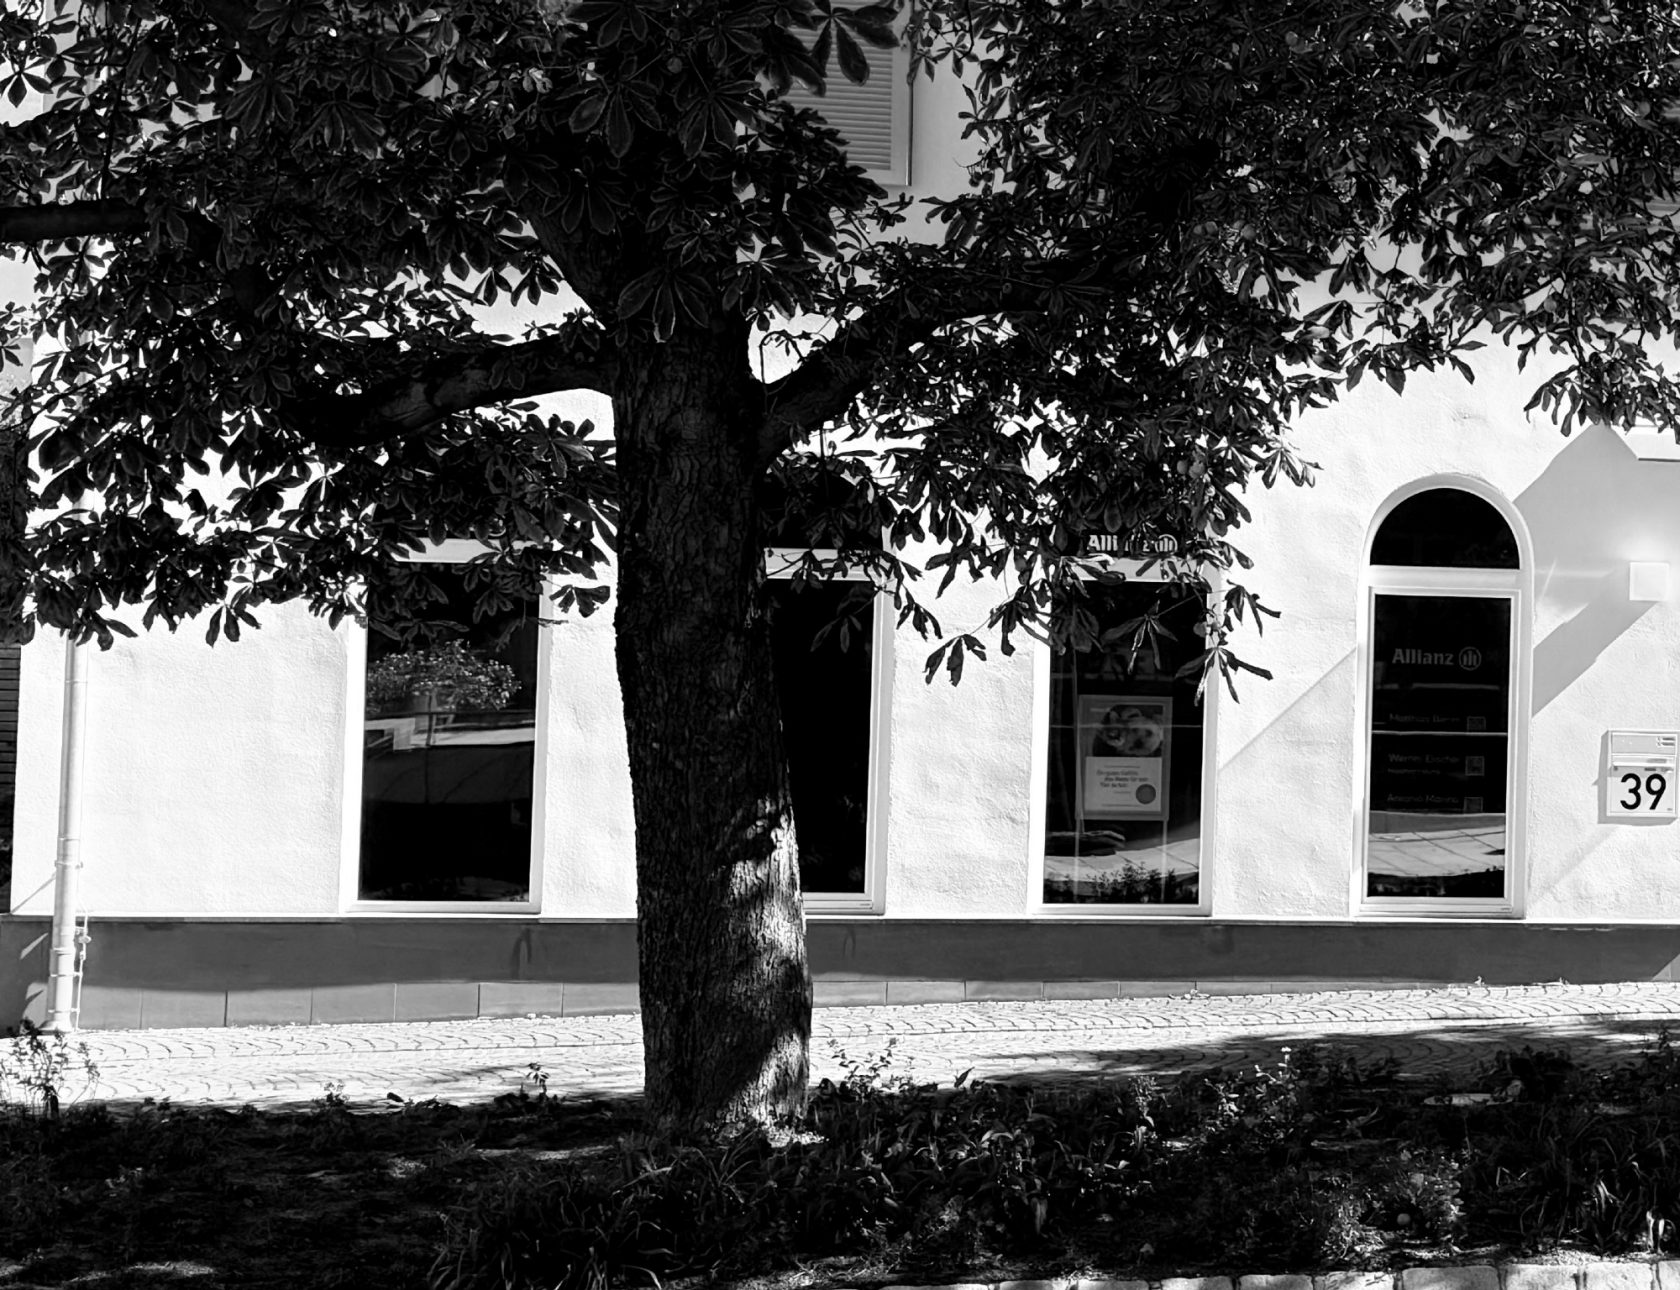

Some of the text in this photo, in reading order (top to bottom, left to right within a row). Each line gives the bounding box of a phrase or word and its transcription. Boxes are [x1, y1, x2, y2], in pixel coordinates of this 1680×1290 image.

[1087, 534, 1151, 552] Alliz
[1392, 648, 1454, 666] Allianz
[1620, 773, 1667, 810] 39
